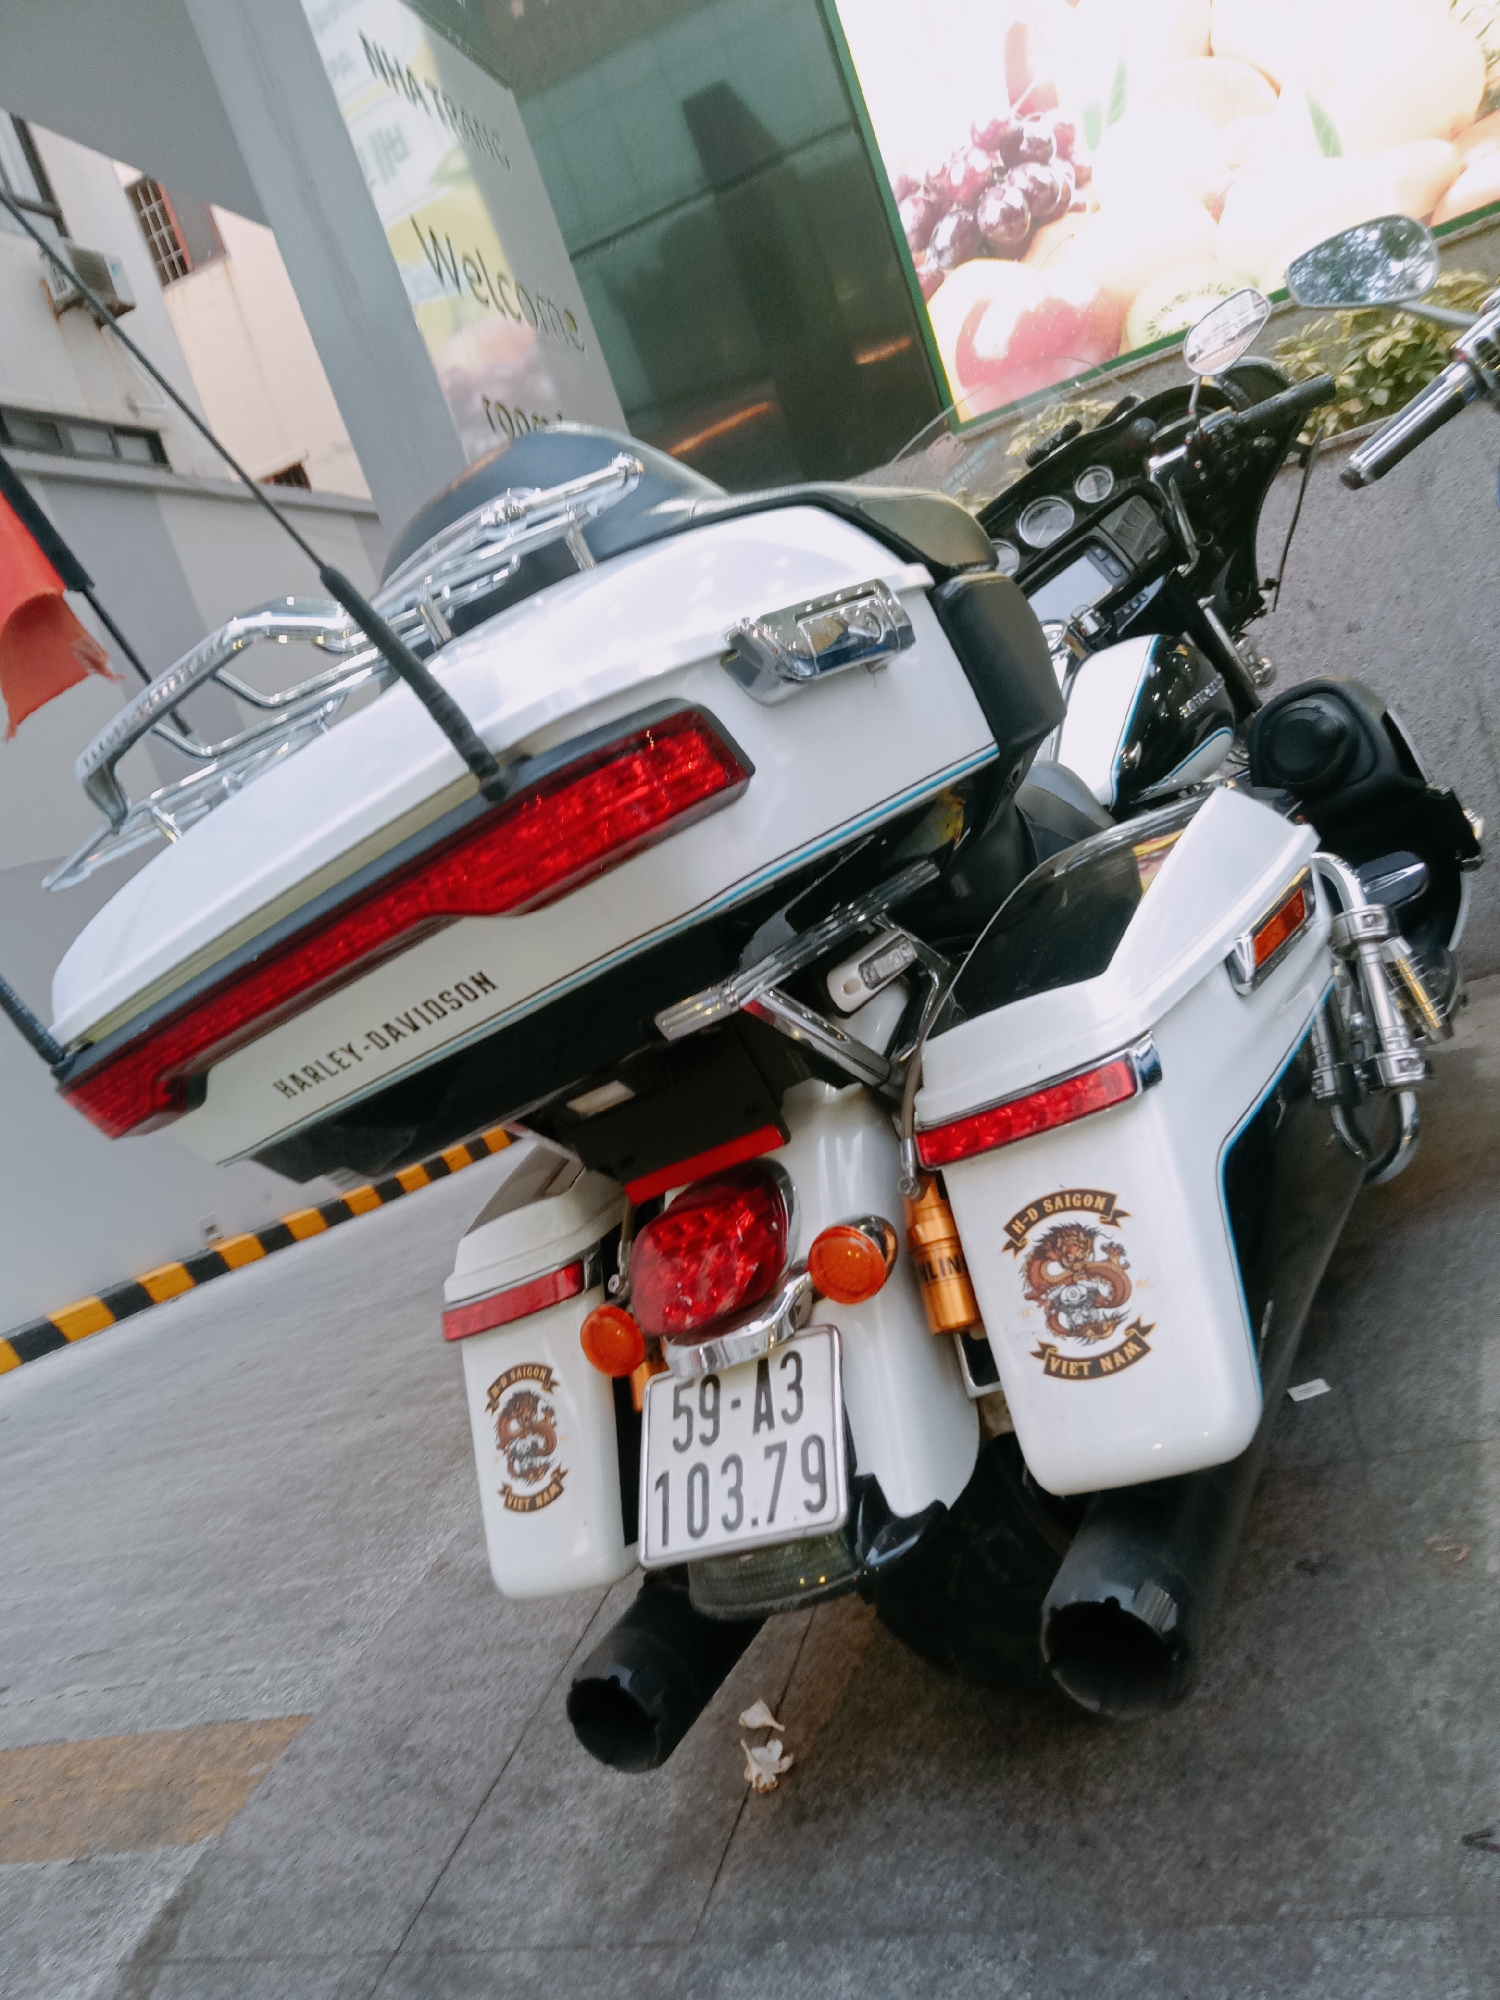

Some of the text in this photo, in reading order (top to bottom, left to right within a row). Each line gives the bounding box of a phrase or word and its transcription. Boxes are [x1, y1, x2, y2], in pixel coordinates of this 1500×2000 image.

[358, 28, 431, 118] NHA
[424, 78, 511, 172] TRANG
[410, 213, 586, 353] Welcome
[272, 970, 498, 1099] HARLEY-DAVIDSON
[1011, 1193, 1108, 1235] H-D SAIGON
[672, 1350, 804, 1454] 59-A3
[1049, 1340, 1143, 1377] VIET NAM
[654, 1433, 828, 1549] 103.79
